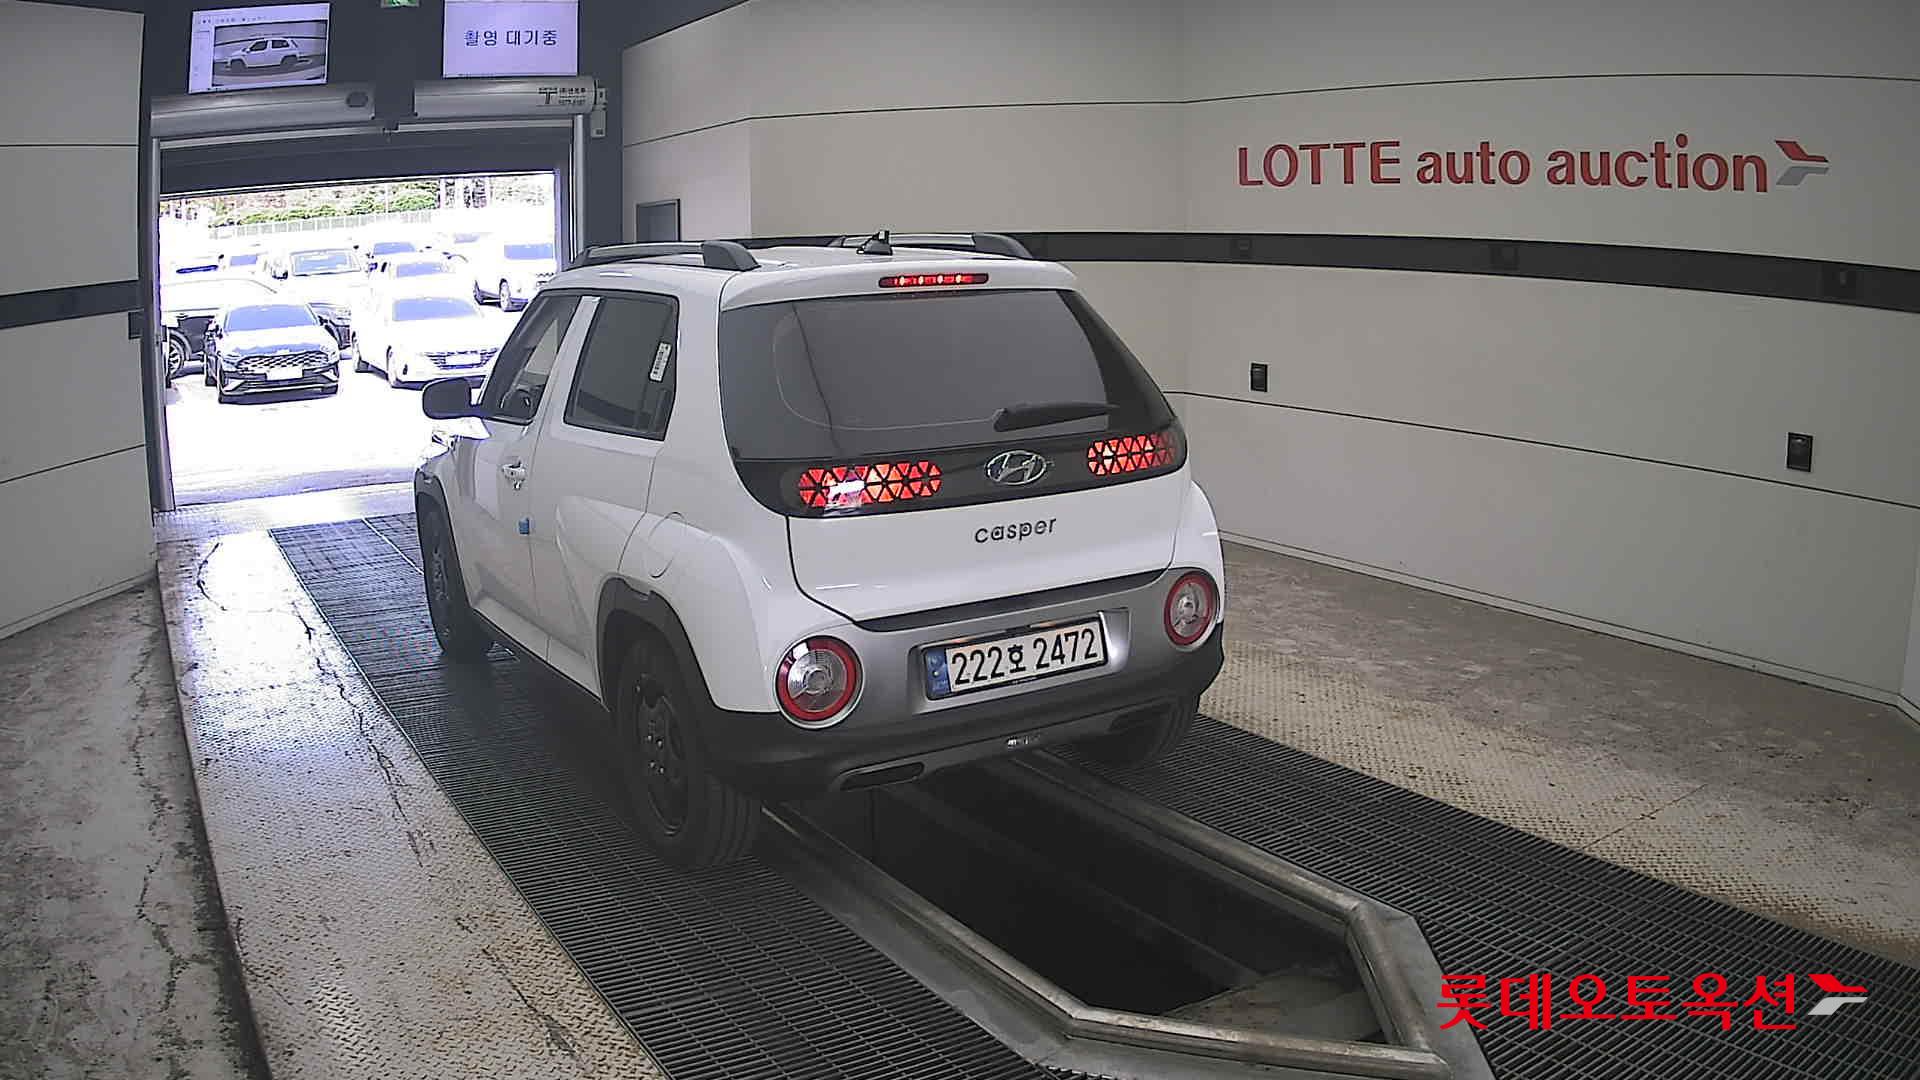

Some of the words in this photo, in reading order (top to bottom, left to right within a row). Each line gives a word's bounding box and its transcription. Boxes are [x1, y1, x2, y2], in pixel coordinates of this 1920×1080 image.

[506, 30, 558, 46] 대기중
[1238, 140, 1400, 187] LOTTE
[1416, 140, 1531, 185] auto
[1546, 132, 1768, 193] auction
[975, 518, 1057, 543] casper
[951, 644, 1026, 685] 222호
[1032, 628, 1098, 670] 2472
